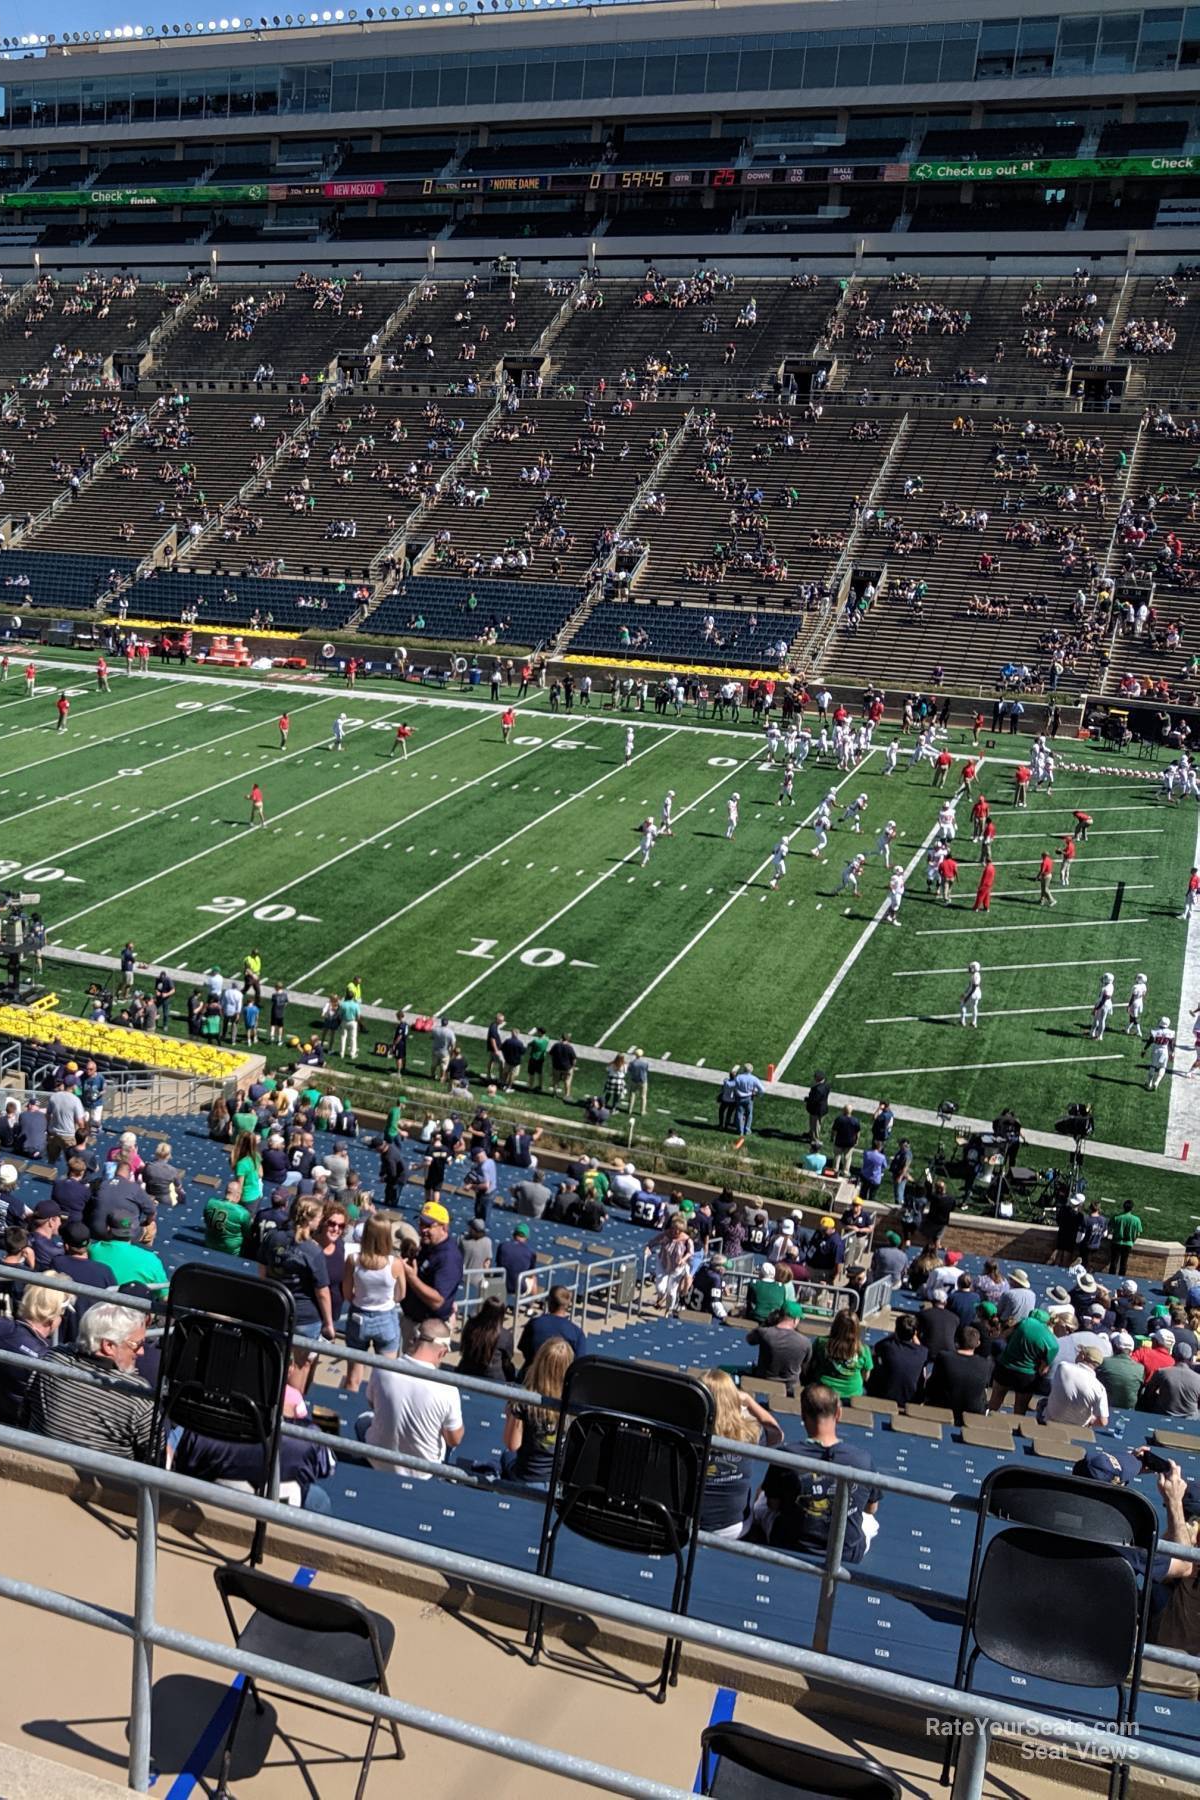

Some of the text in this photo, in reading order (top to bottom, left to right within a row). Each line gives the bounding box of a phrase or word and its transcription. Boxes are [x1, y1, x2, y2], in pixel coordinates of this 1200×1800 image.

[937, 161, 1034, 176] Check us out at
[1152, 158, 1194, 169] Check
[492, 177, 540, 190] NOTRE DAME
[589, 173, 601, 189] 0
[622, 171, 664, 188] 59:45
[674, 174, 690, 183] QTR
[713, 168, 736, 186] 25
[333, 183, 376, 195] NEW MEXICO
[422, 178, 433, 195] 0
[91, 191, 123, 202] Check
[130, 197, 157, 205] finish
[195, 896, 296, 921] 20
[455, 938, 566, 967] 10
[375, 1044, 387, 1055] 10
[291, 1150, 303, 1167] 5
[634, 1201, 656, 1221] 33
[812, 1484, 823, 1496] 19
